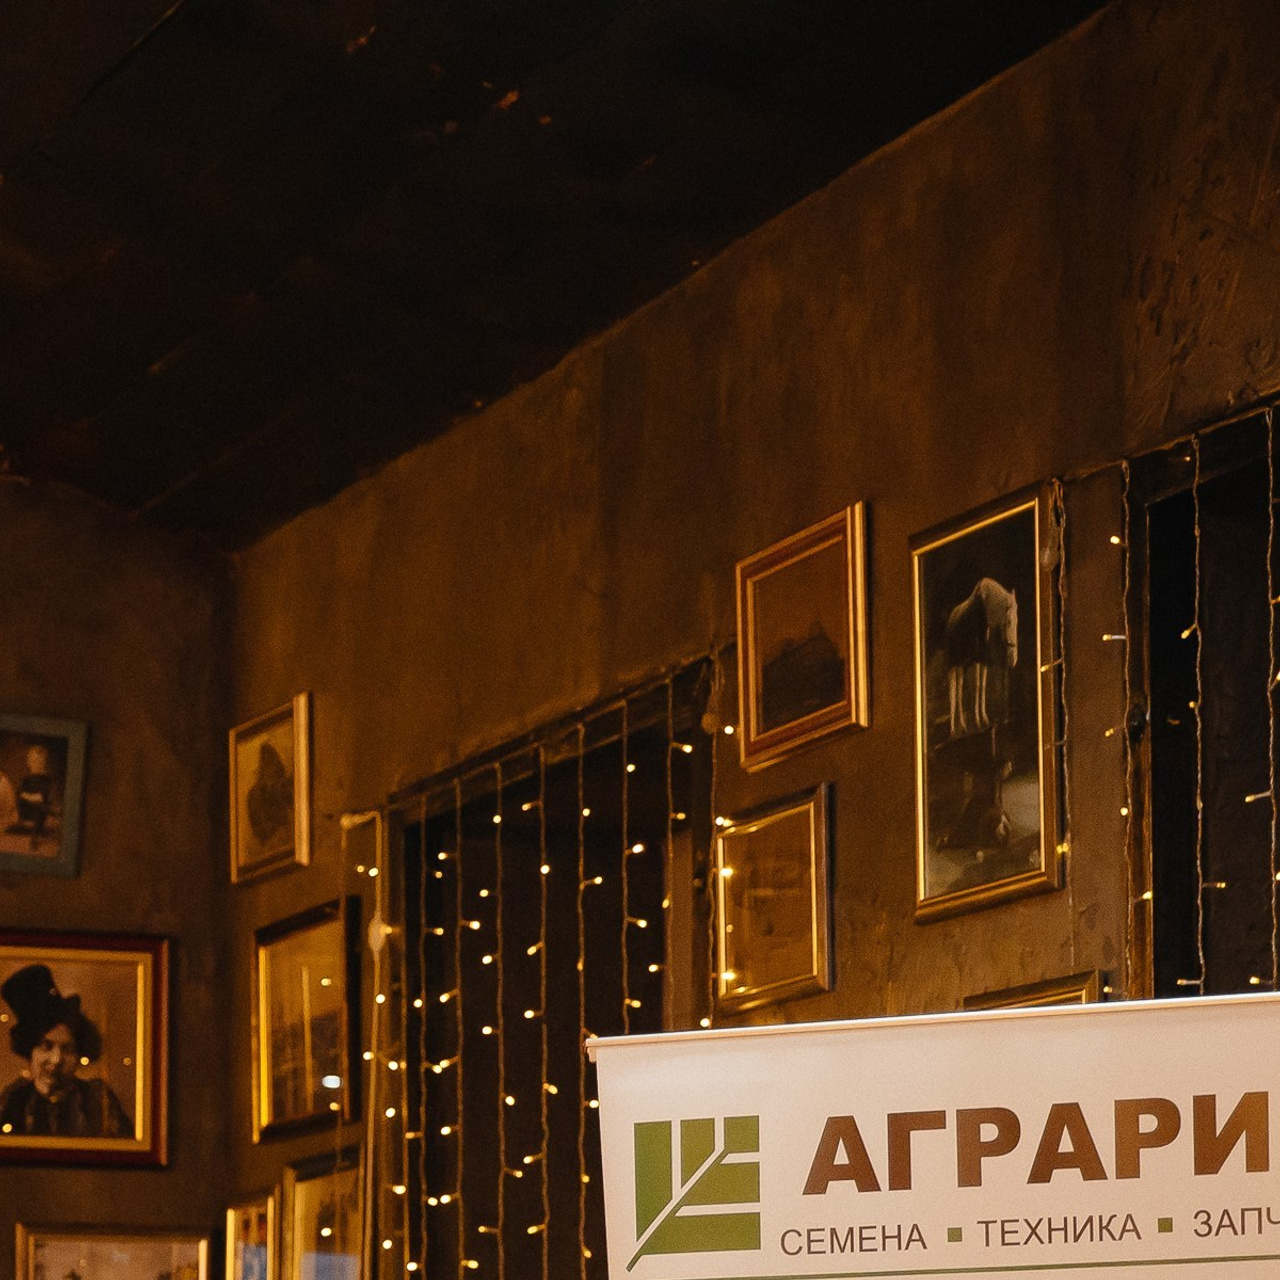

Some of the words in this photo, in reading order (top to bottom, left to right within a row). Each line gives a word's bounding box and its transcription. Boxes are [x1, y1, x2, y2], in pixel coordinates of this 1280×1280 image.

[802, 1090, 1270, 1195] АГРАРИ
[780, 1223, 927, 1255] СЕМЕНА
[977, 1213, 1141, 1247] ТЕХНИКА
